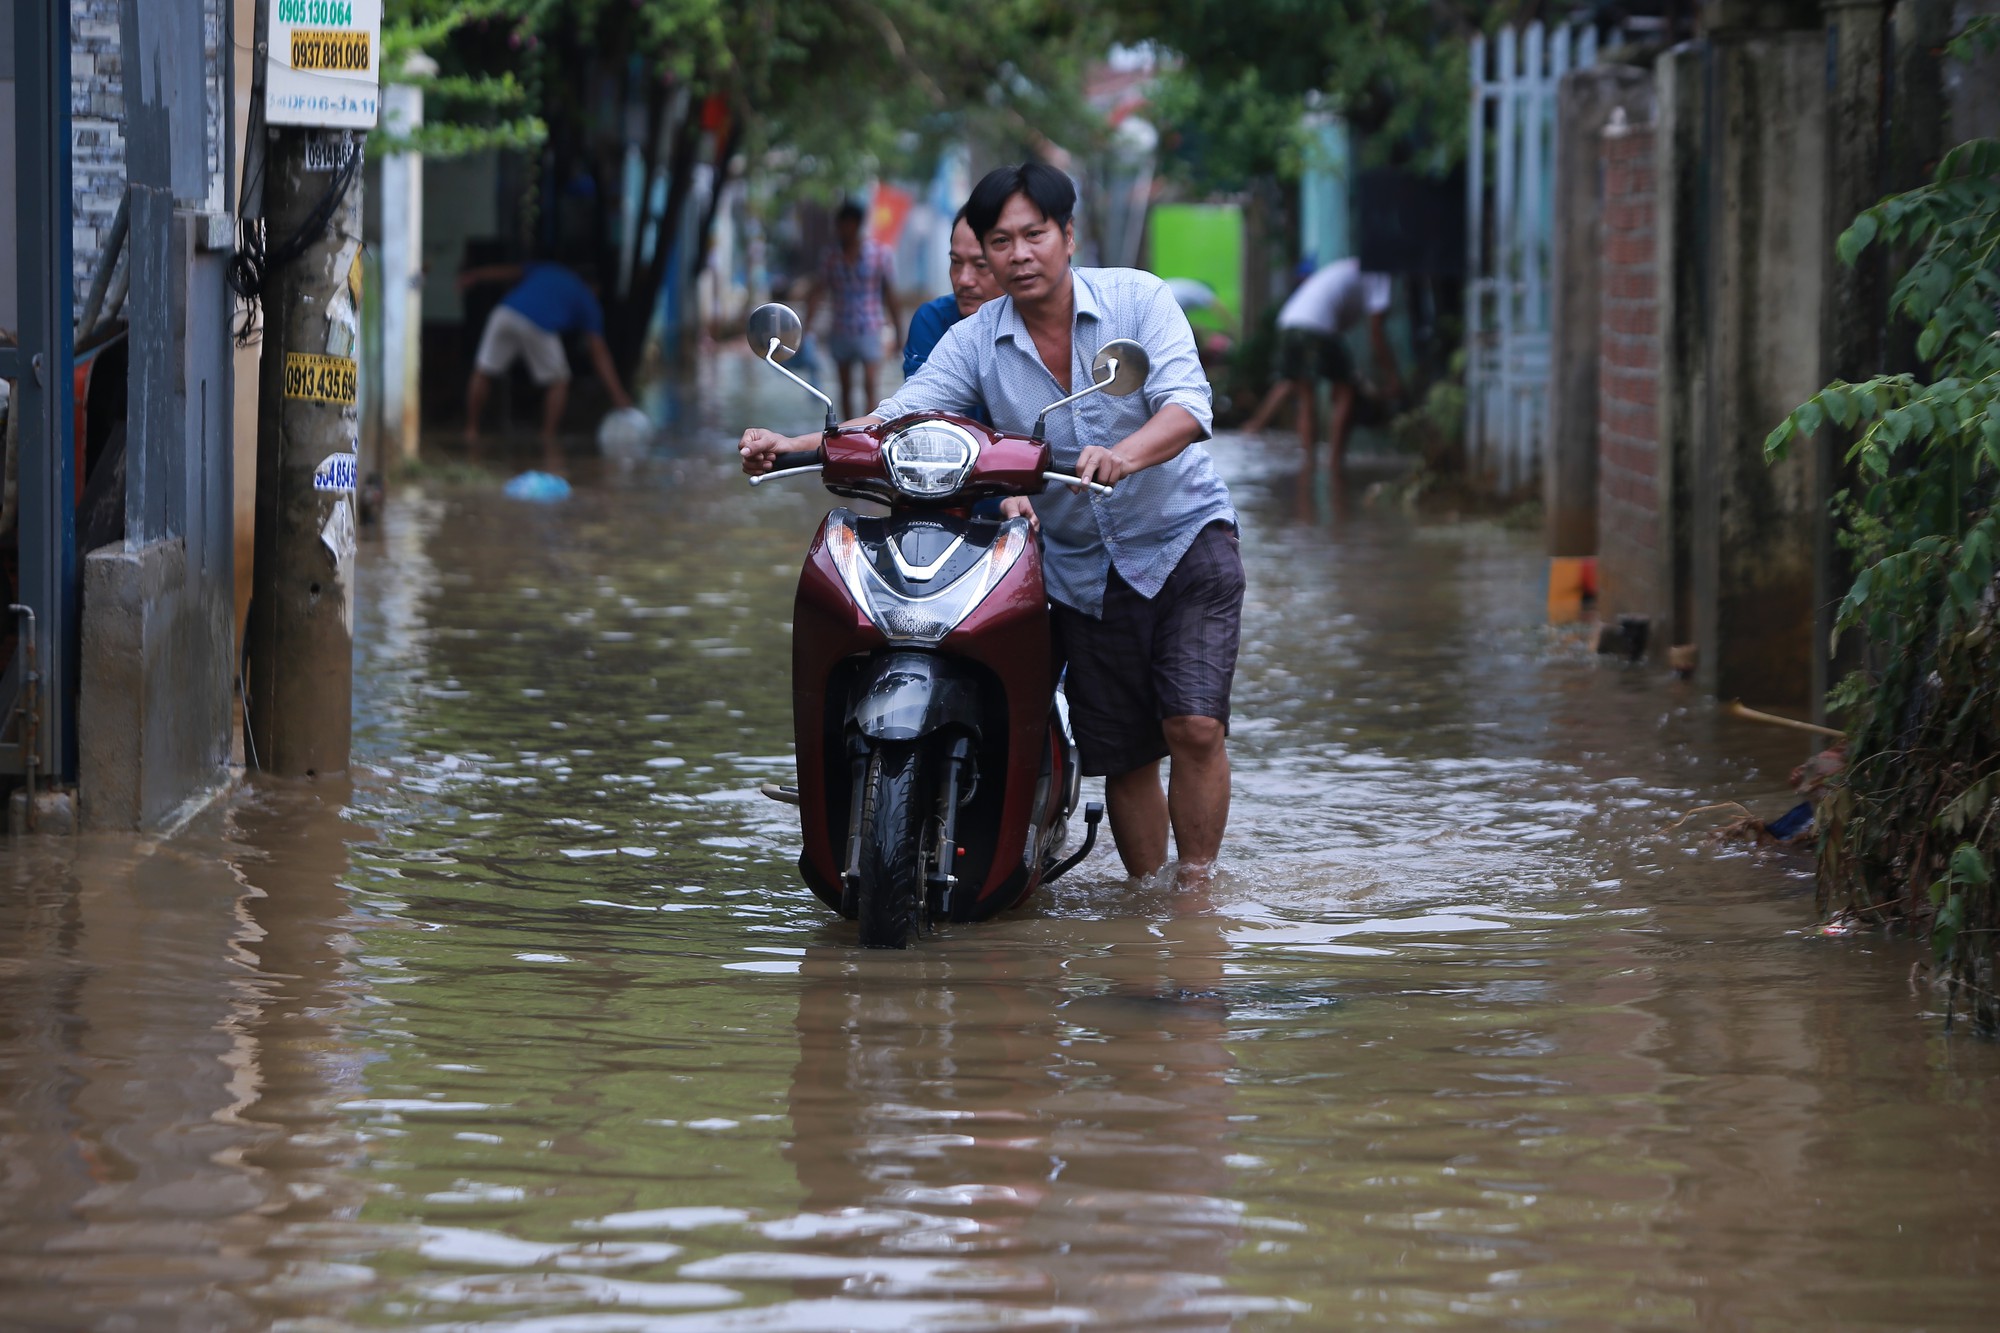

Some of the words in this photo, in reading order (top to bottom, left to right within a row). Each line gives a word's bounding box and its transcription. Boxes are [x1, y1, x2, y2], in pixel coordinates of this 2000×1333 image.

[279, 0, 351, 26] 0905.130.064
[293, 41, 368, 68] 0937.881.008
[286, 363, 356, 401] 0913.435.694
[907, 520, 945, 529] HONDA
